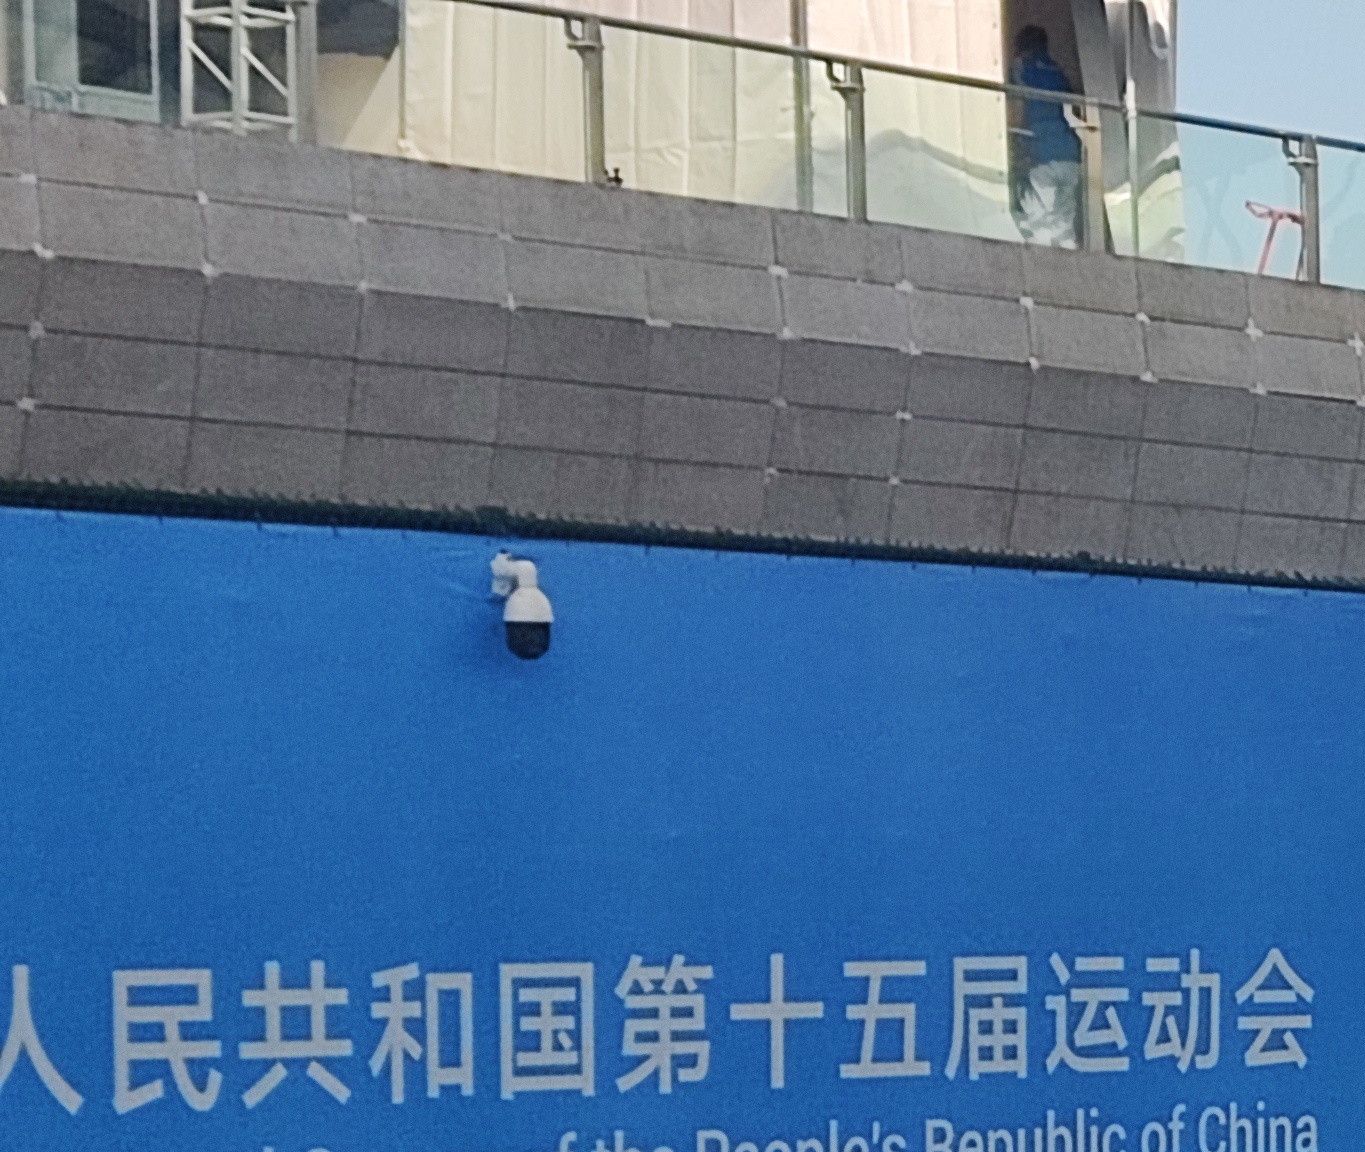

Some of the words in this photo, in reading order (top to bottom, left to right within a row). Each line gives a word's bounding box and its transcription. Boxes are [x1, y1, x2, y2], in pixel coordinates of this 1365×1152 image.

[0, 948, 1315, 1115] 人民共和国第十五届运动会
